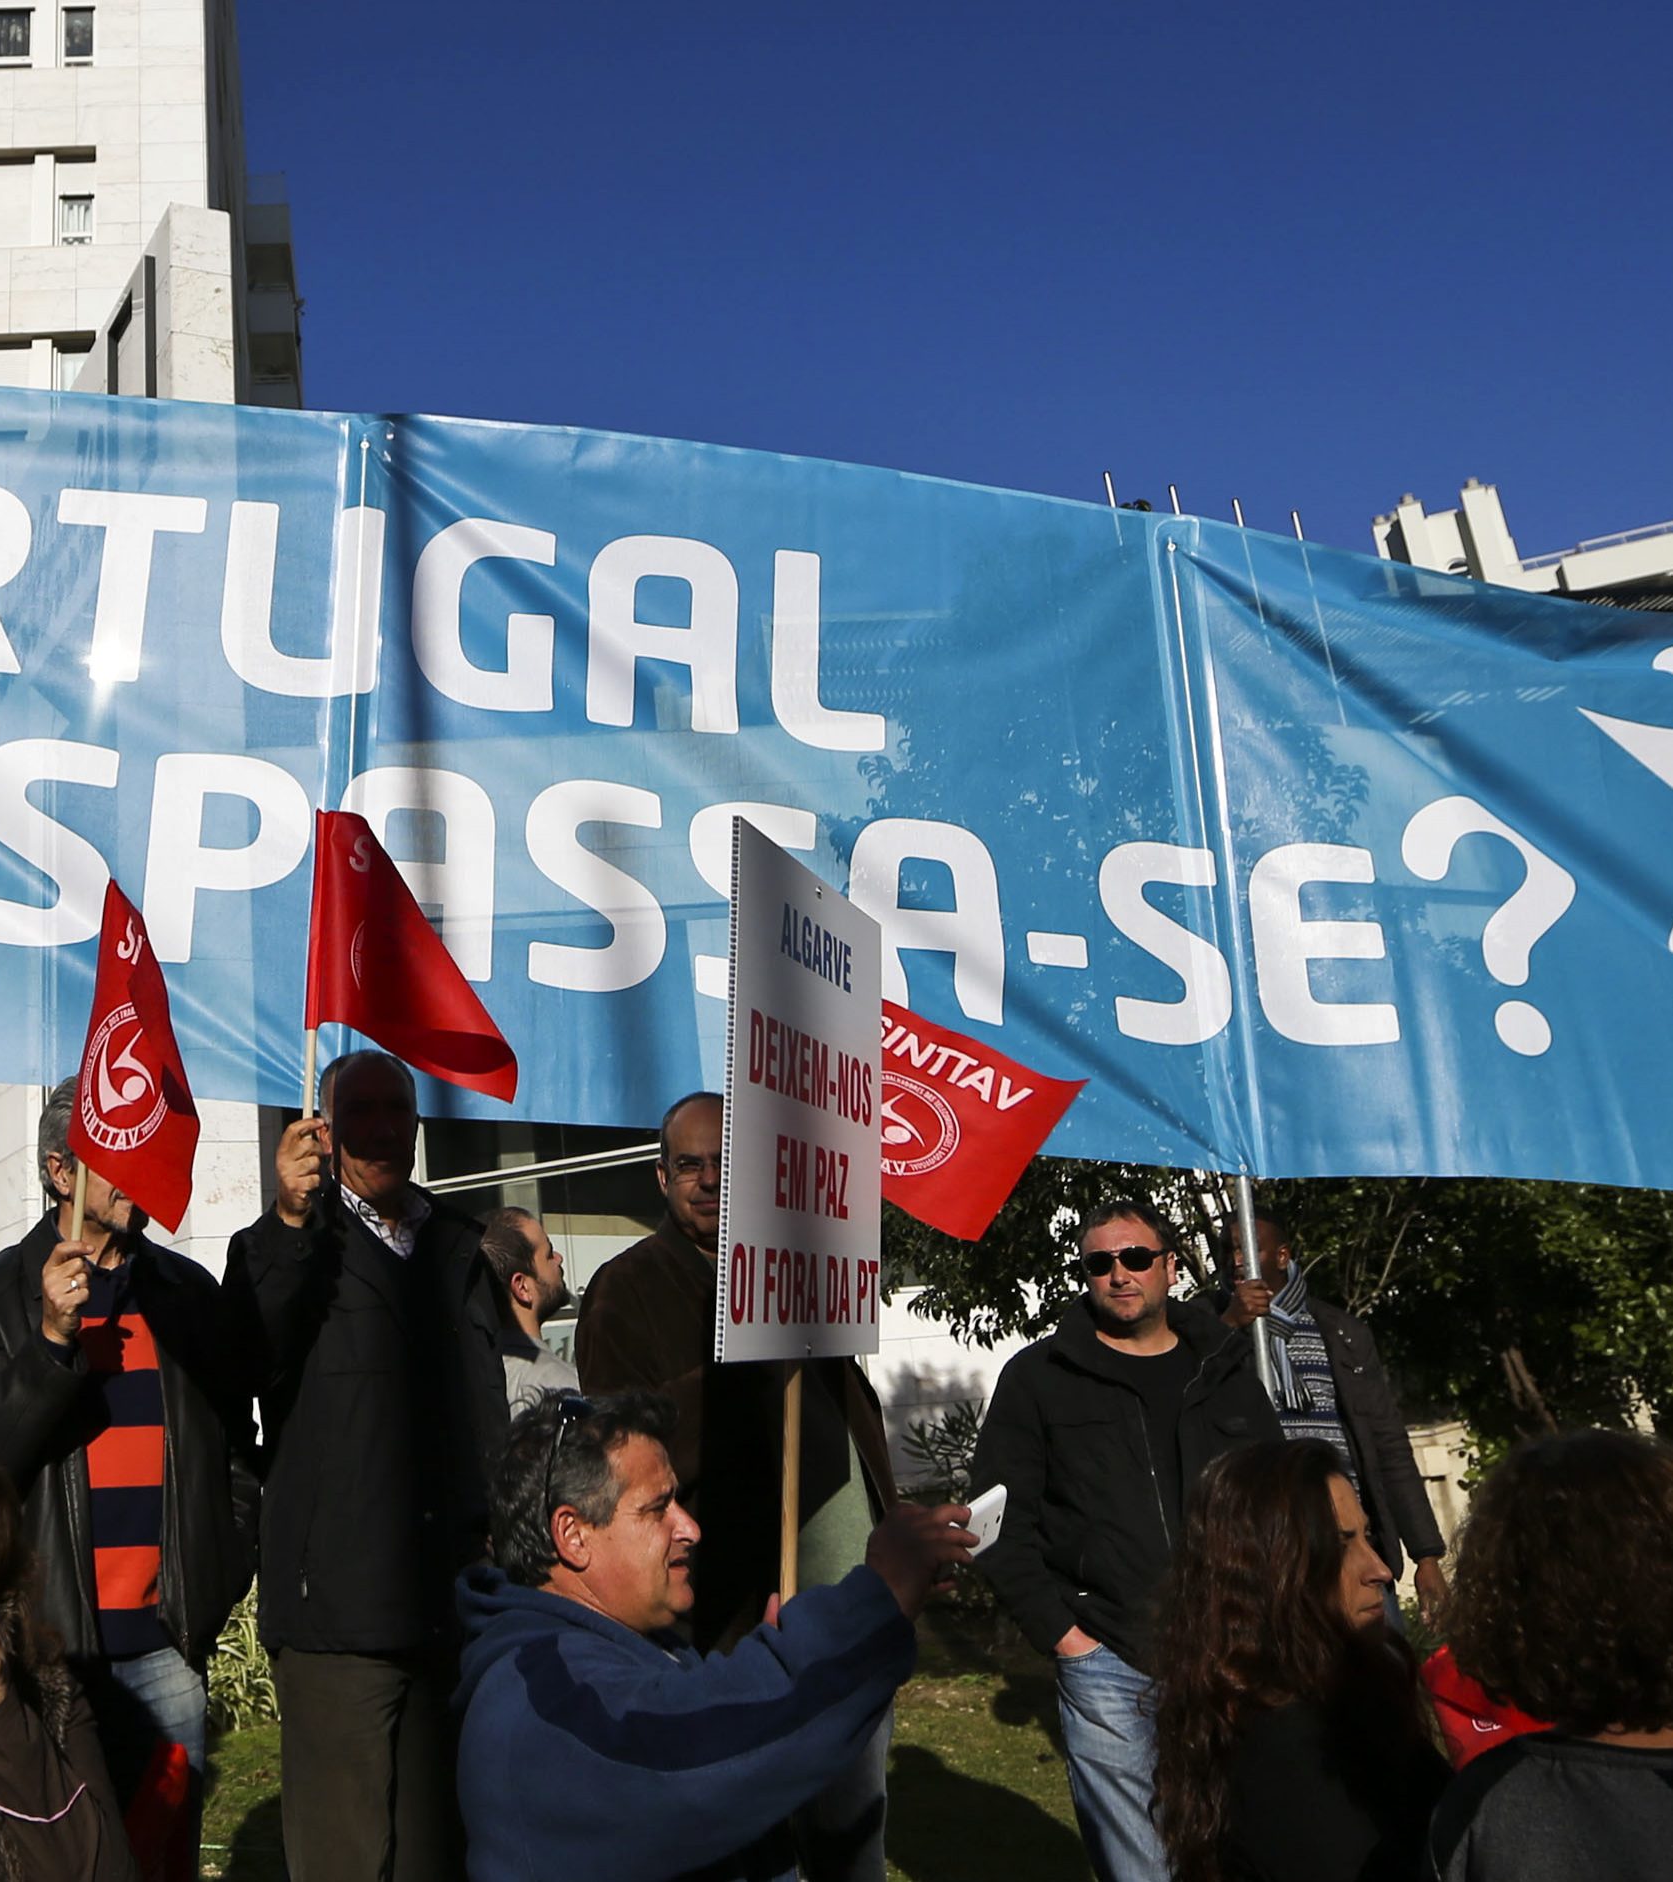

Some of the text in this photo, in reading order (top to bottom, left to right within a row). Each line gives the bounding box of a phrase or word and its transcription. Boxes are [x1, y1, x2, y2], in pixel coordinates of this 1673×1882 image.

[780, 903, 852, 994] ALGARVE
[748, 1007, 872, 1128] DEIXEM-NOS
[881, 1015, 1034, 1112] SINTTAV
[774, 1133, 850, 1221] EM PAZ
[730, 1242, 879, 1325] OI FORA DA PT
